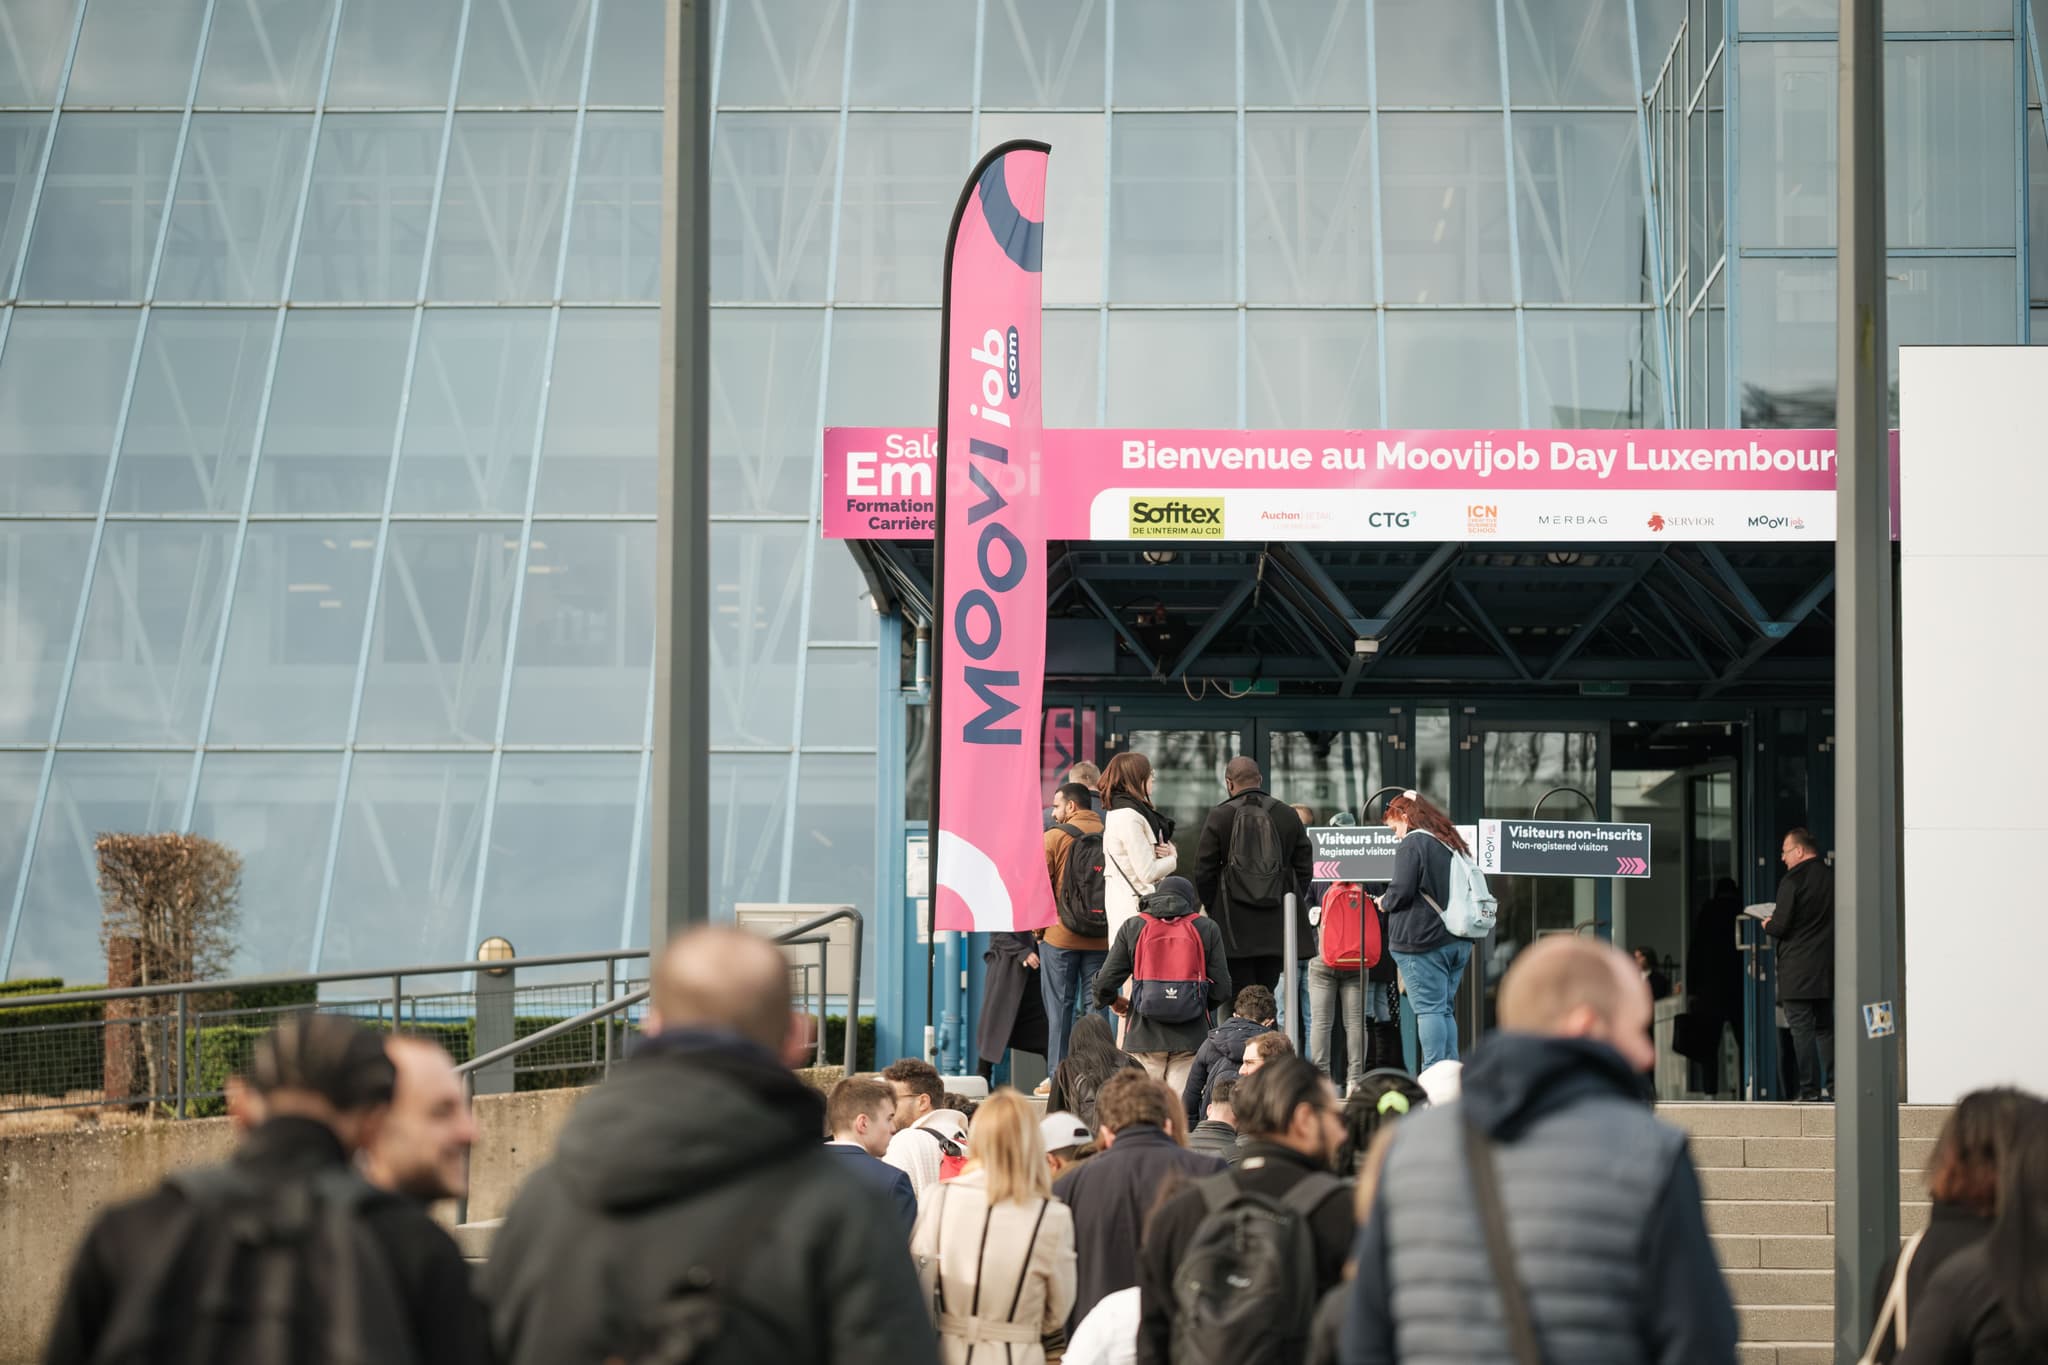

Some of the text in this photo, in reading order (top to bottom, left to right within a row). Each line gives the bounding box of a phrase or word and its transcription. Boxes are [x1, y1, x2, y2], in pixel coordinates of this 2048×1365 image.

[970, 328, 1011, 428] job
[1122, 440, 1837, 479] Bienvenue au Moovijob Day Luxembour
[1132, 502, 1221, 524] Sofitex
[1260, 510, 1300, 520] Auchan
[1467, 504, 1498, 518] ICN
[1368, 511, 1411, 528] CTG
[1538, 515, 1609, 525] MERBAG
[1667, 516, 1715, 527] SERVIOR
[1748, 514, 1789, 529] MOOVI
[1132, 527, 1145, 535] DE
[1191, 527, 1203, 535] AU
[1205, 527, 1221, 535] CDI
[955, 438, 1027, 745] MOOVI
[1316, 832, 1402, 845] Visiteurs insc
[1509, 825, 1565, 839] Visiteurs
[1567, 828, 1643, 842] non-inscrits
[1319, 846, 1396, 858] Registered visitors
[1484, 836, 1495, 867] MOOVI
[1511, 840, 1609, 852] Non-registered visitors
